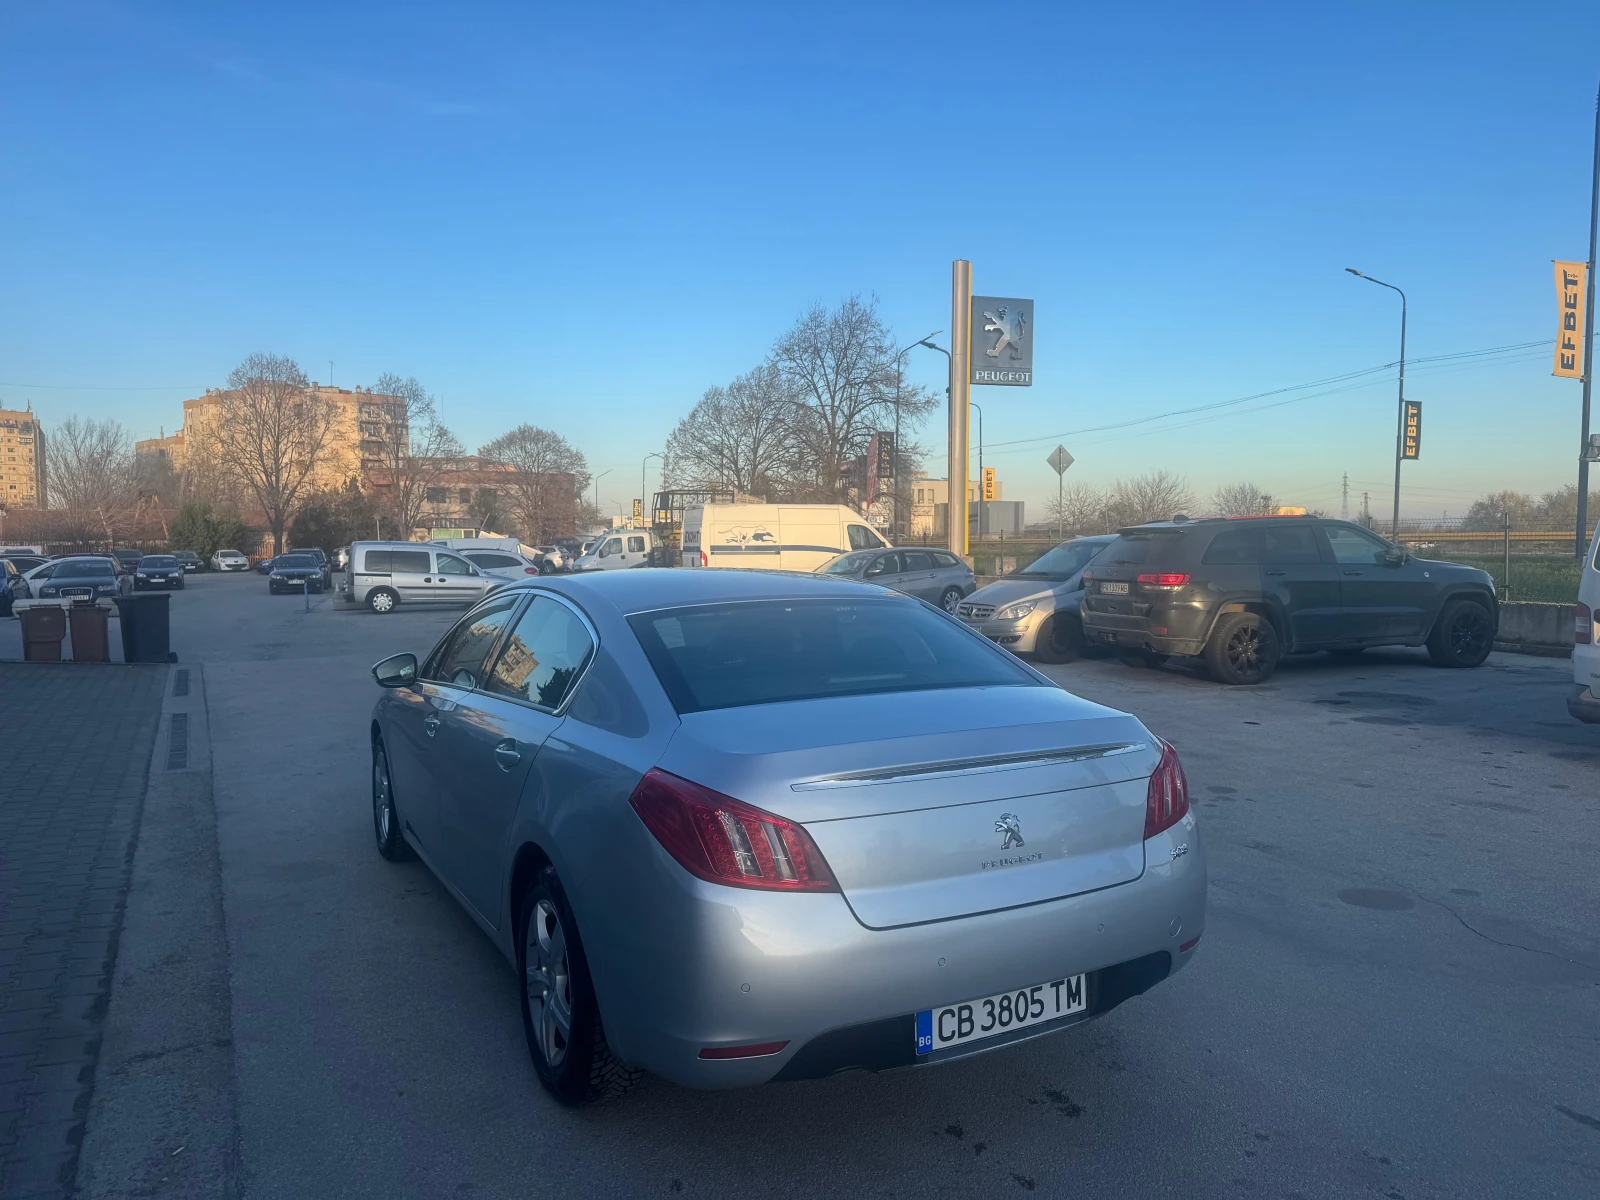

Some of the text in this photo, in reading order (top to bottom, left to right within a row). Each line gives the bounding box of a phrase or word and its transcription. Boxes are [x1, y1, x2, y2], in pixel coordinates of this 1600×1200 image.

[1561, 269, 1578, 371] EFBET
[975, 370, 1032, 382] PEUGEOT
[1406, 404, 1418, 457] EFBET
[981, 852, 1043, 869] PEUGEOT
[938, 975, 1082, 1042] CB 3805 TM
[918, 1036, 932, 1047] BG
